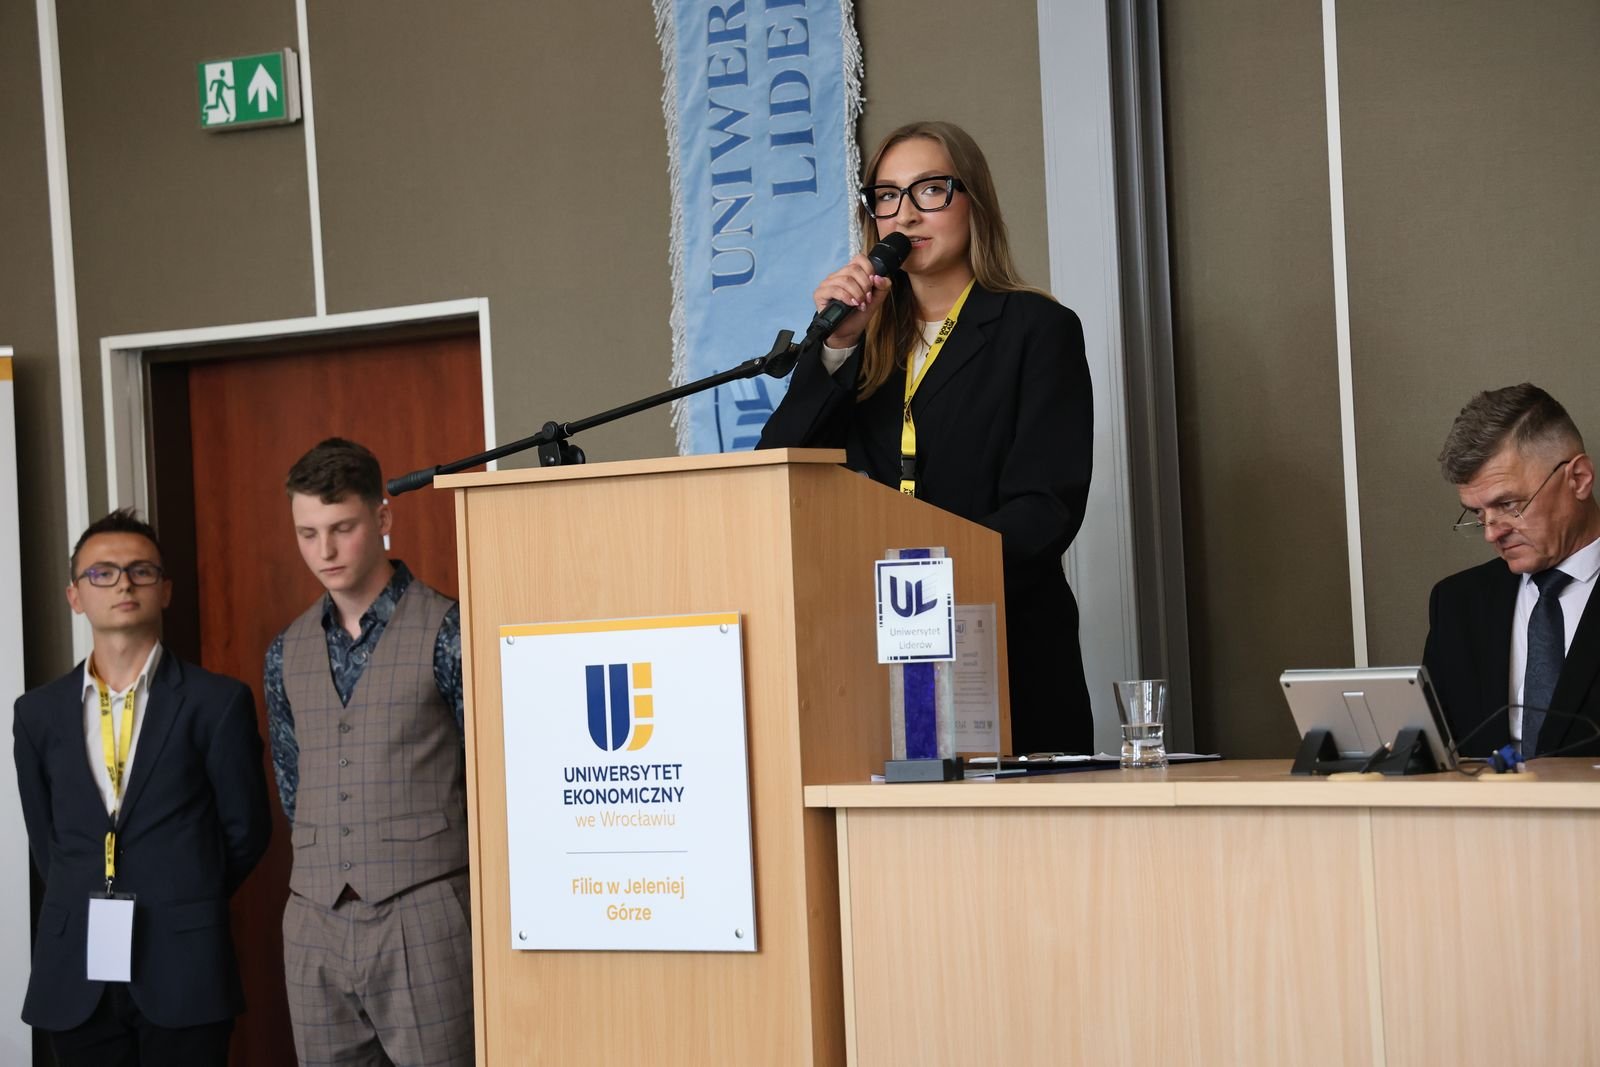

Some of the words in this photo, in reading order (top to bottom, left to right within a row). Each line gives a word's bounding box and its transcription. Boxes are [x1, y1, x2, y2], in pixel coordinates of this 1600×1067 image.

[889, 626, 940, 638] Uniwersytet
[898, 640, 933, 650] Liderów
[564, 764, 682, 783] UNIWERSYTET
[563, 786, 684, 805] EKONOMICZNY
[575, 816, 596, 827] we
[599, 809, 676, 827] Wrocławiu
[572, 877, 603, 895] Filia
[606, 881, 620, 895] w
[624, 876, 685, 900] Jeleniej
[606, 902, 652, 921] Górze
